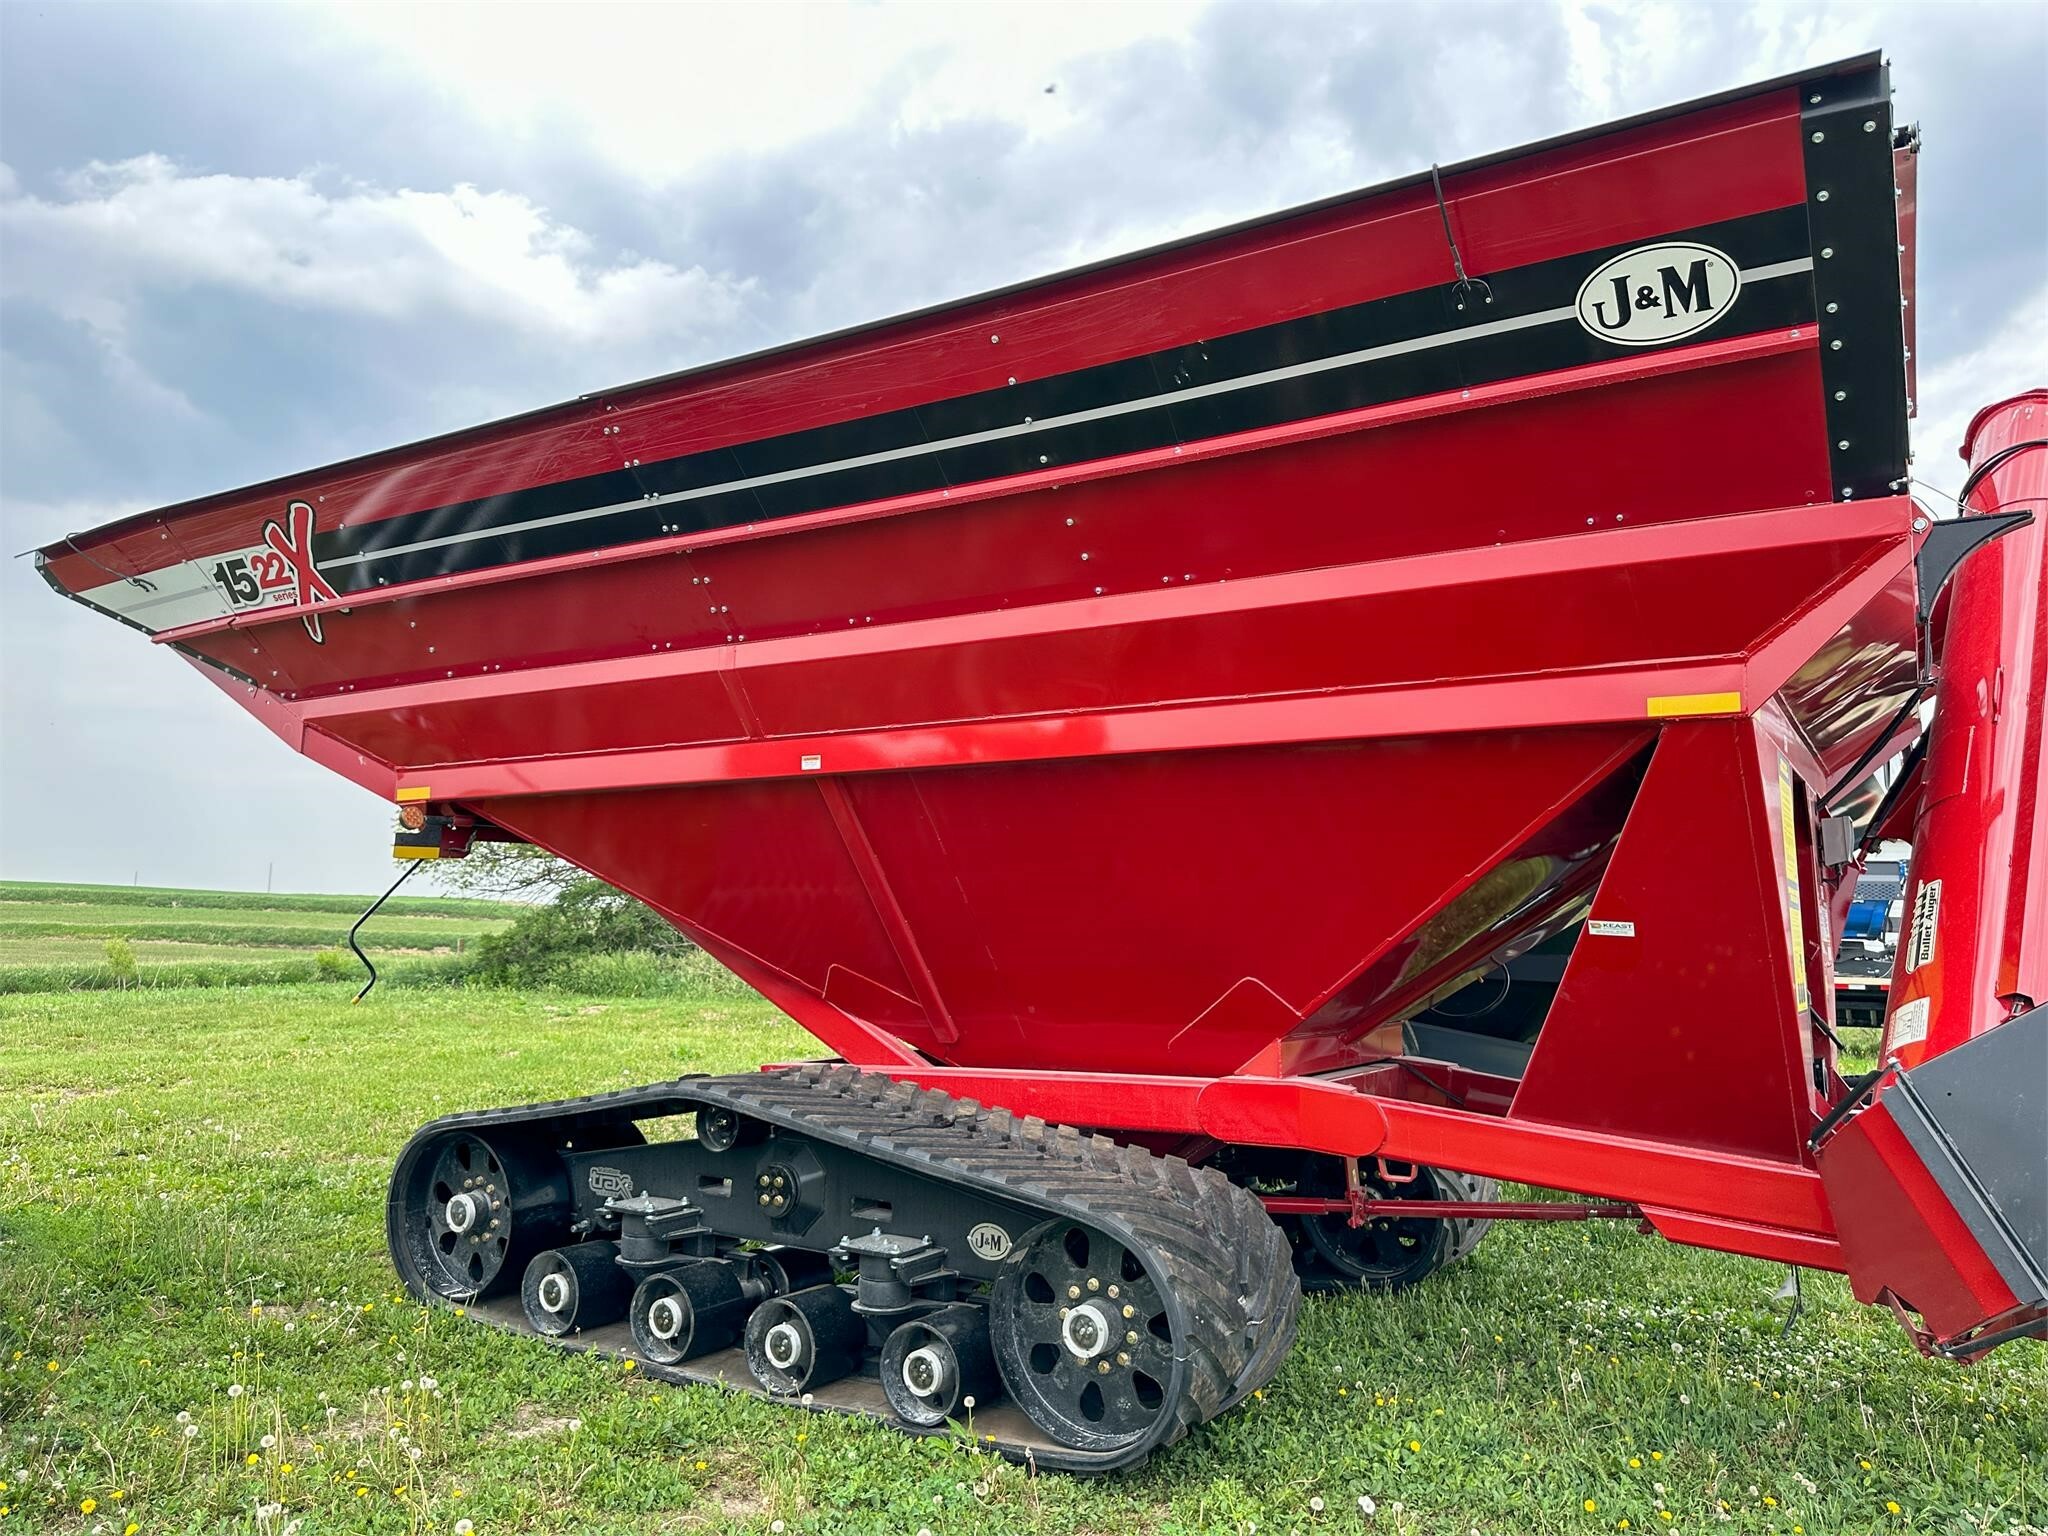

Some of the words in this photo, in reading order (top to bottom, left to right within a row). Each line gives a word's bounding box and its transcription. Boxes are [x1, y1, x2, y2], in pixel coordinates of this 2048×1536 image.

[1592, 258, 1714, 330] J&M
[273, 591, 298, 602] series
[1925, 886, 1937, 921] Auger
[1920, 925, 1932, 961] Bullet
[592, 1170, 632, 1199] trax
[975, 1232, 1001, 1251] J&M
